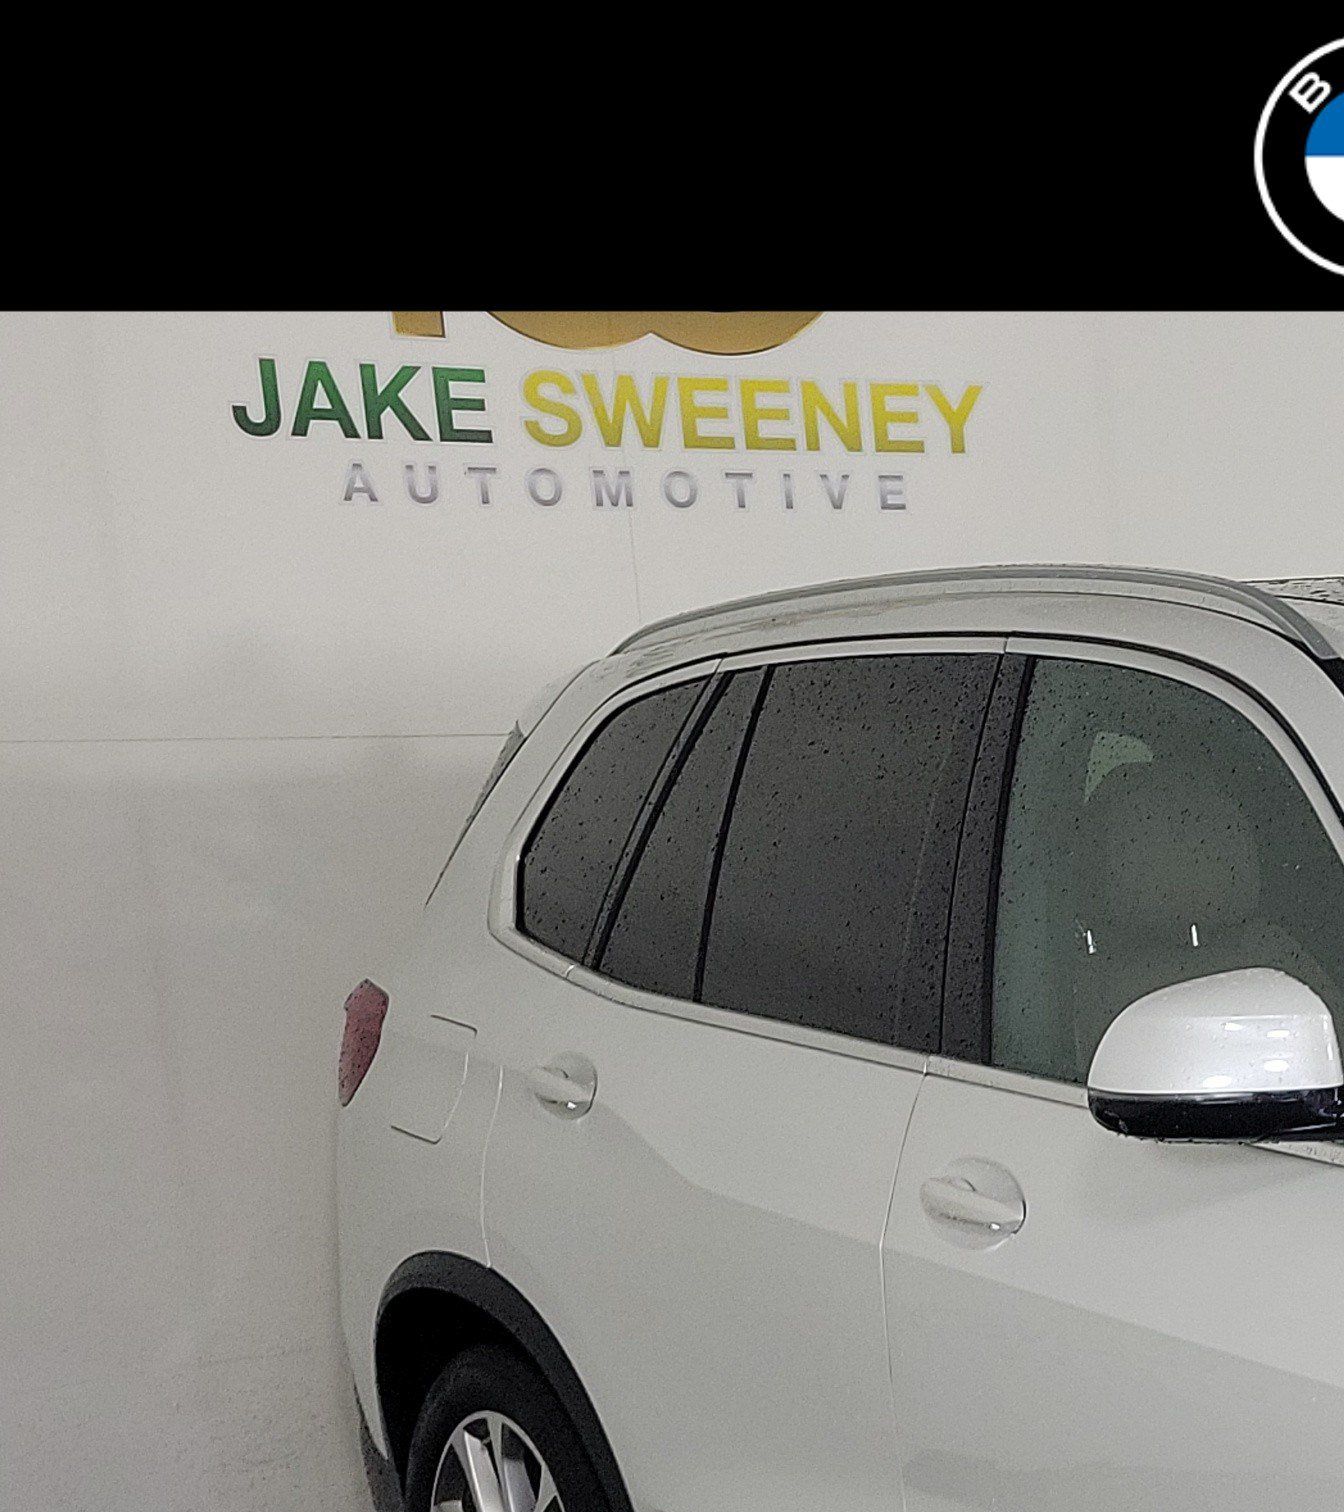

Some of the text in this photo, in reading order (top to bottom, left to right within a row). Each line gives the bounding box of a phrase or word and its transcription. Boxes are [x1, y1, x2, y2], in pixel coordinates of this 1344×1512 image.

[231, 358, 984, 454] JAKE SWEENEY
[342, 462, 908, 511] AUTOMOTIVE
